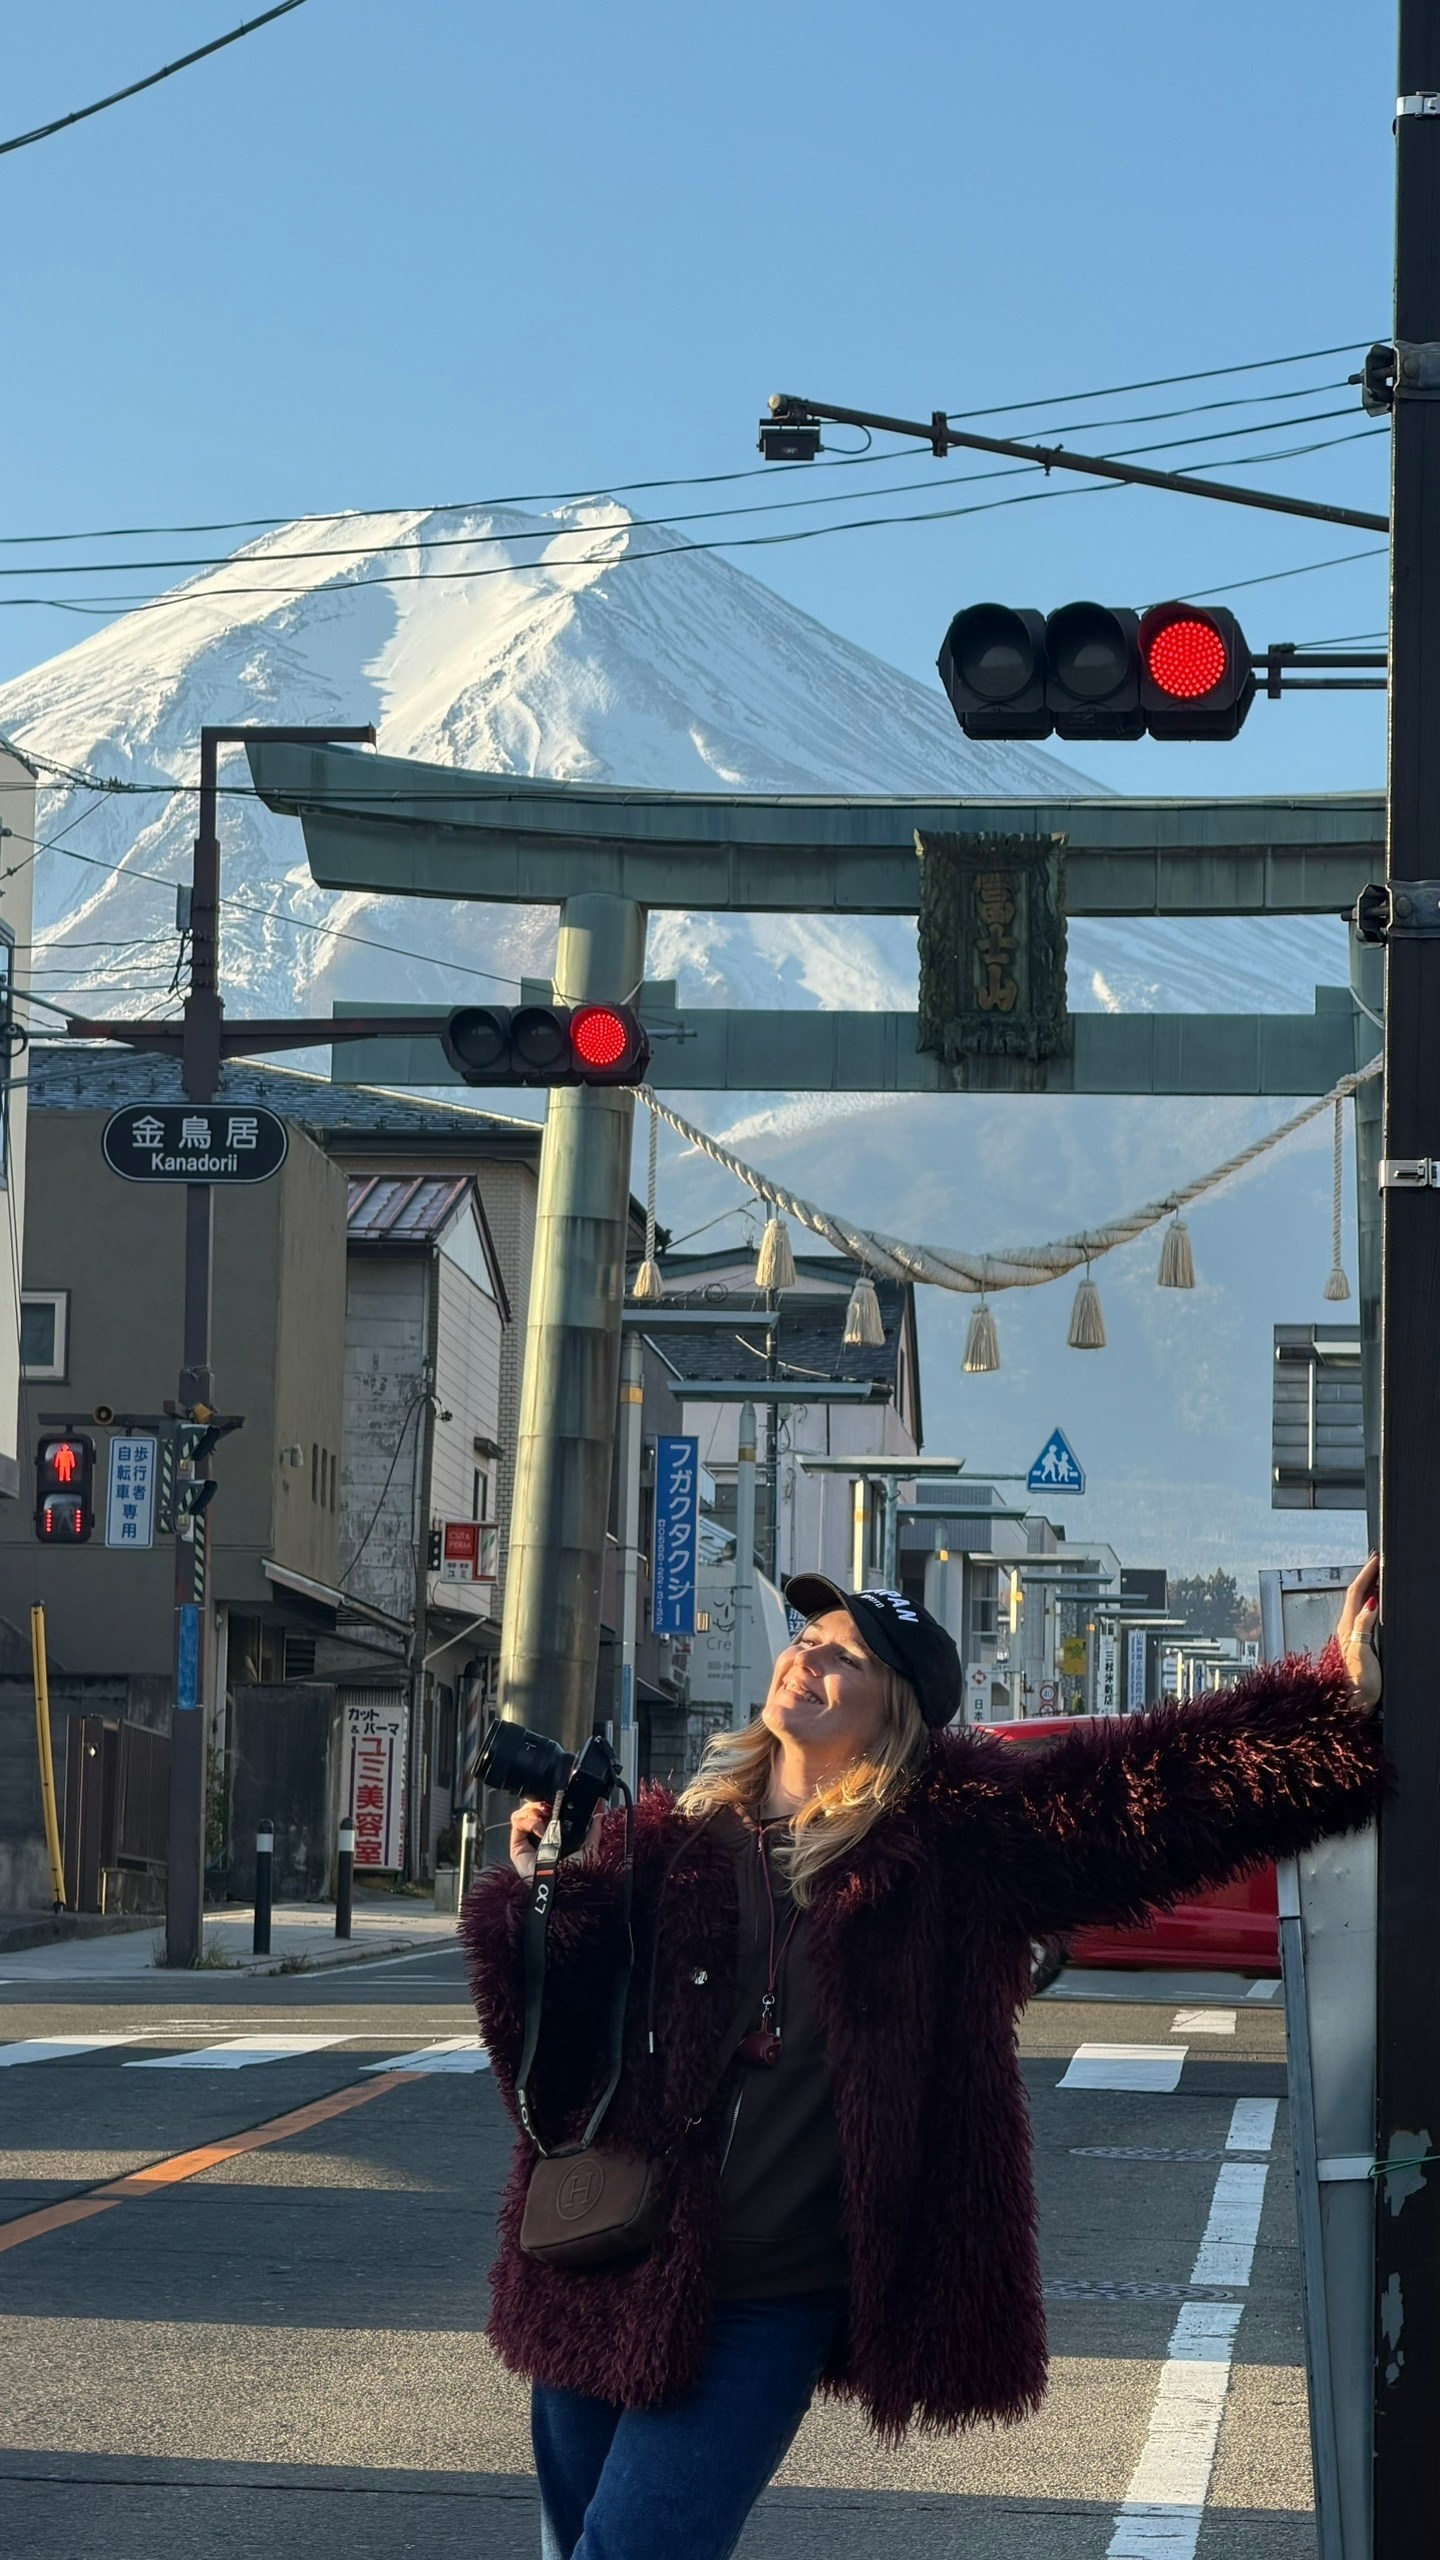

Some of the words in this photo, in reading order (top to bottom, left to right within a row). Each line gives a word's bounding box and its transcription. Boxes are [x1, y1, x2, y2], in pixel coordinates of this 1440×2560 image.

[131, 1115, 260, 1150] 金鳥居
[151, 1152, 238, 1173] Kanadorii
[116, 1446, 131, 1500] 自転車
[133, 1446, 148, 1500] 歩行者
[121, 1504, 138, 1538] 専用
[667, 1444, 693, 1625] フガクタクシー
[857, 1589, 919, 1622] PAN
[348, 1708, 380, 1722] カット
[364, 1722, 400, 1736] パーマ
[353, 1737, 387, 1865] ユミ美容室
[564, 2170, 595, 2209] H
